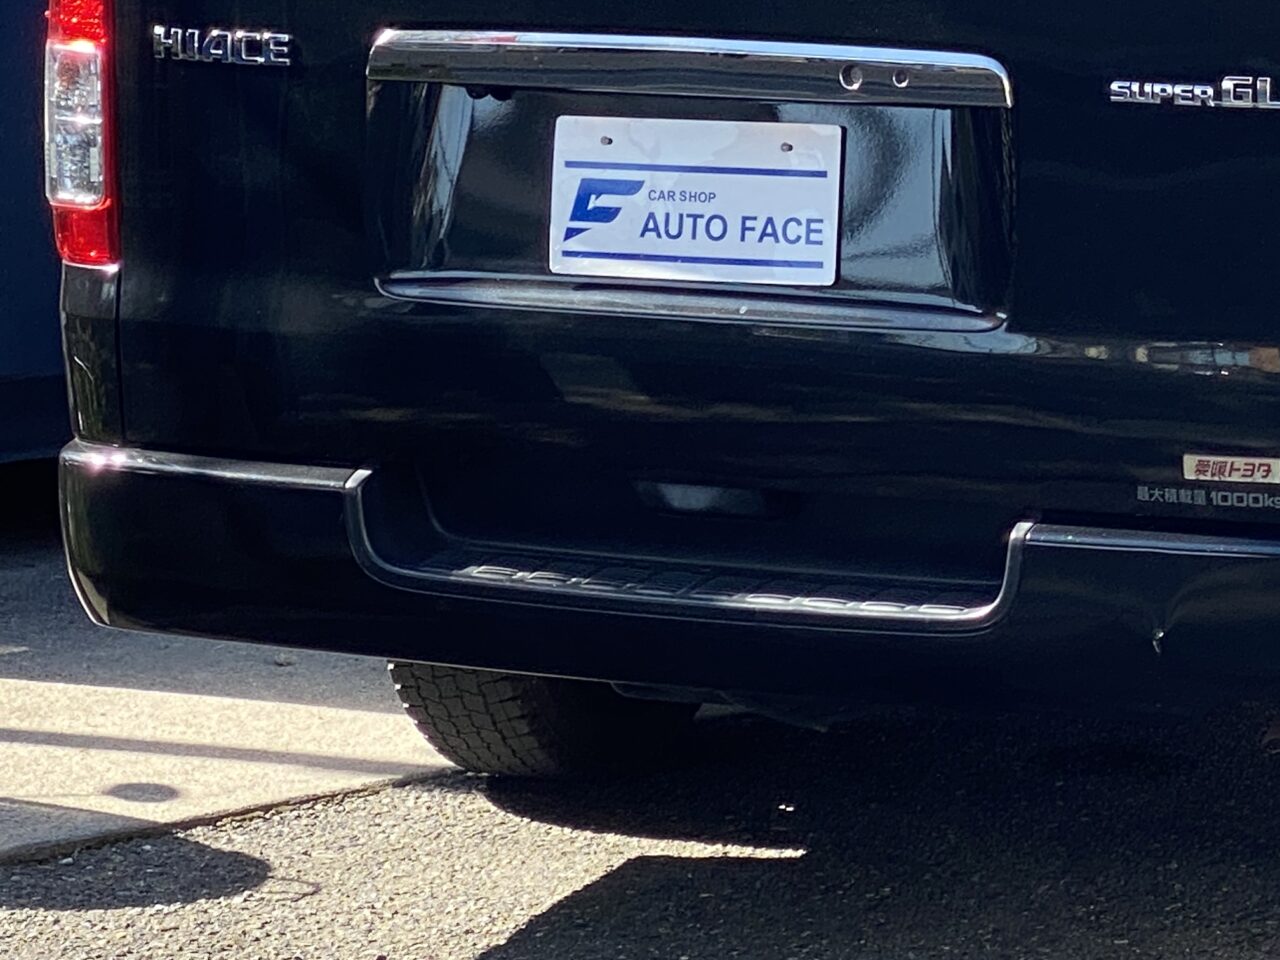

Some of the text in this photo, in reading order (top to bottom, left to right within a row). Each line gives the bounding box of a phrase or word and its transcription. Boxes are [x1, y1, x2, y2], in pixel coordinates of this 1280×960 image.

[153, 25, 291, 65] HIACE
[1110, 81, 1215, 107] SUPER
[648, 190, 716, 203] CAR SHOP
[640, 211, 824, 245] AUTO FACE
[1194, 459, 1272, 478] 愛媛トヨタ
[1137, 486, 1206, 505] 最大積載量
